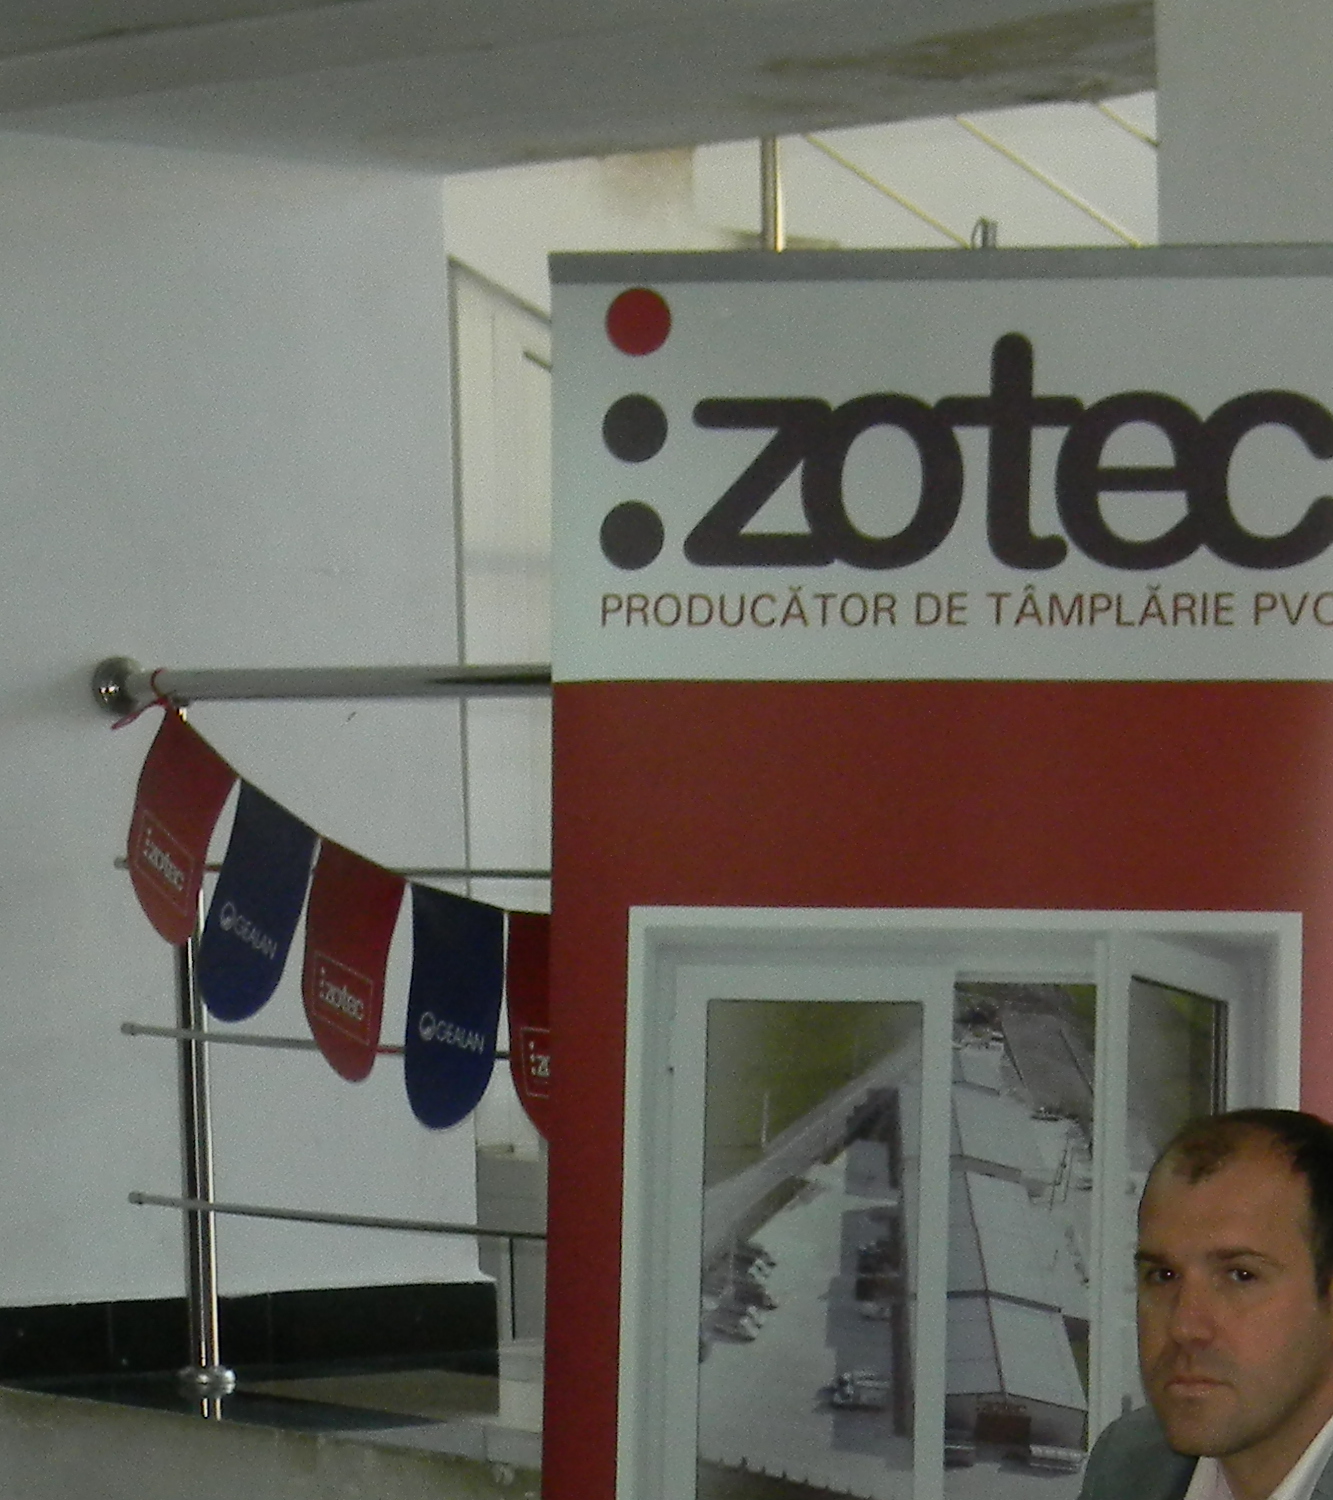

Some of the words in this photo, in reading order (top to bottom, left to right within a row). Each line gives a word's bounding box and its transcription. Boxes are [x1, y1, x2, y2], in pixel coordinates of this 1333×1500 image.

[600, 584, 897, 629] PRODUCĂTOR
[914, 592, 968, 628] DE
[986, 583, 1236, 629] TÂMPLĂRIE
